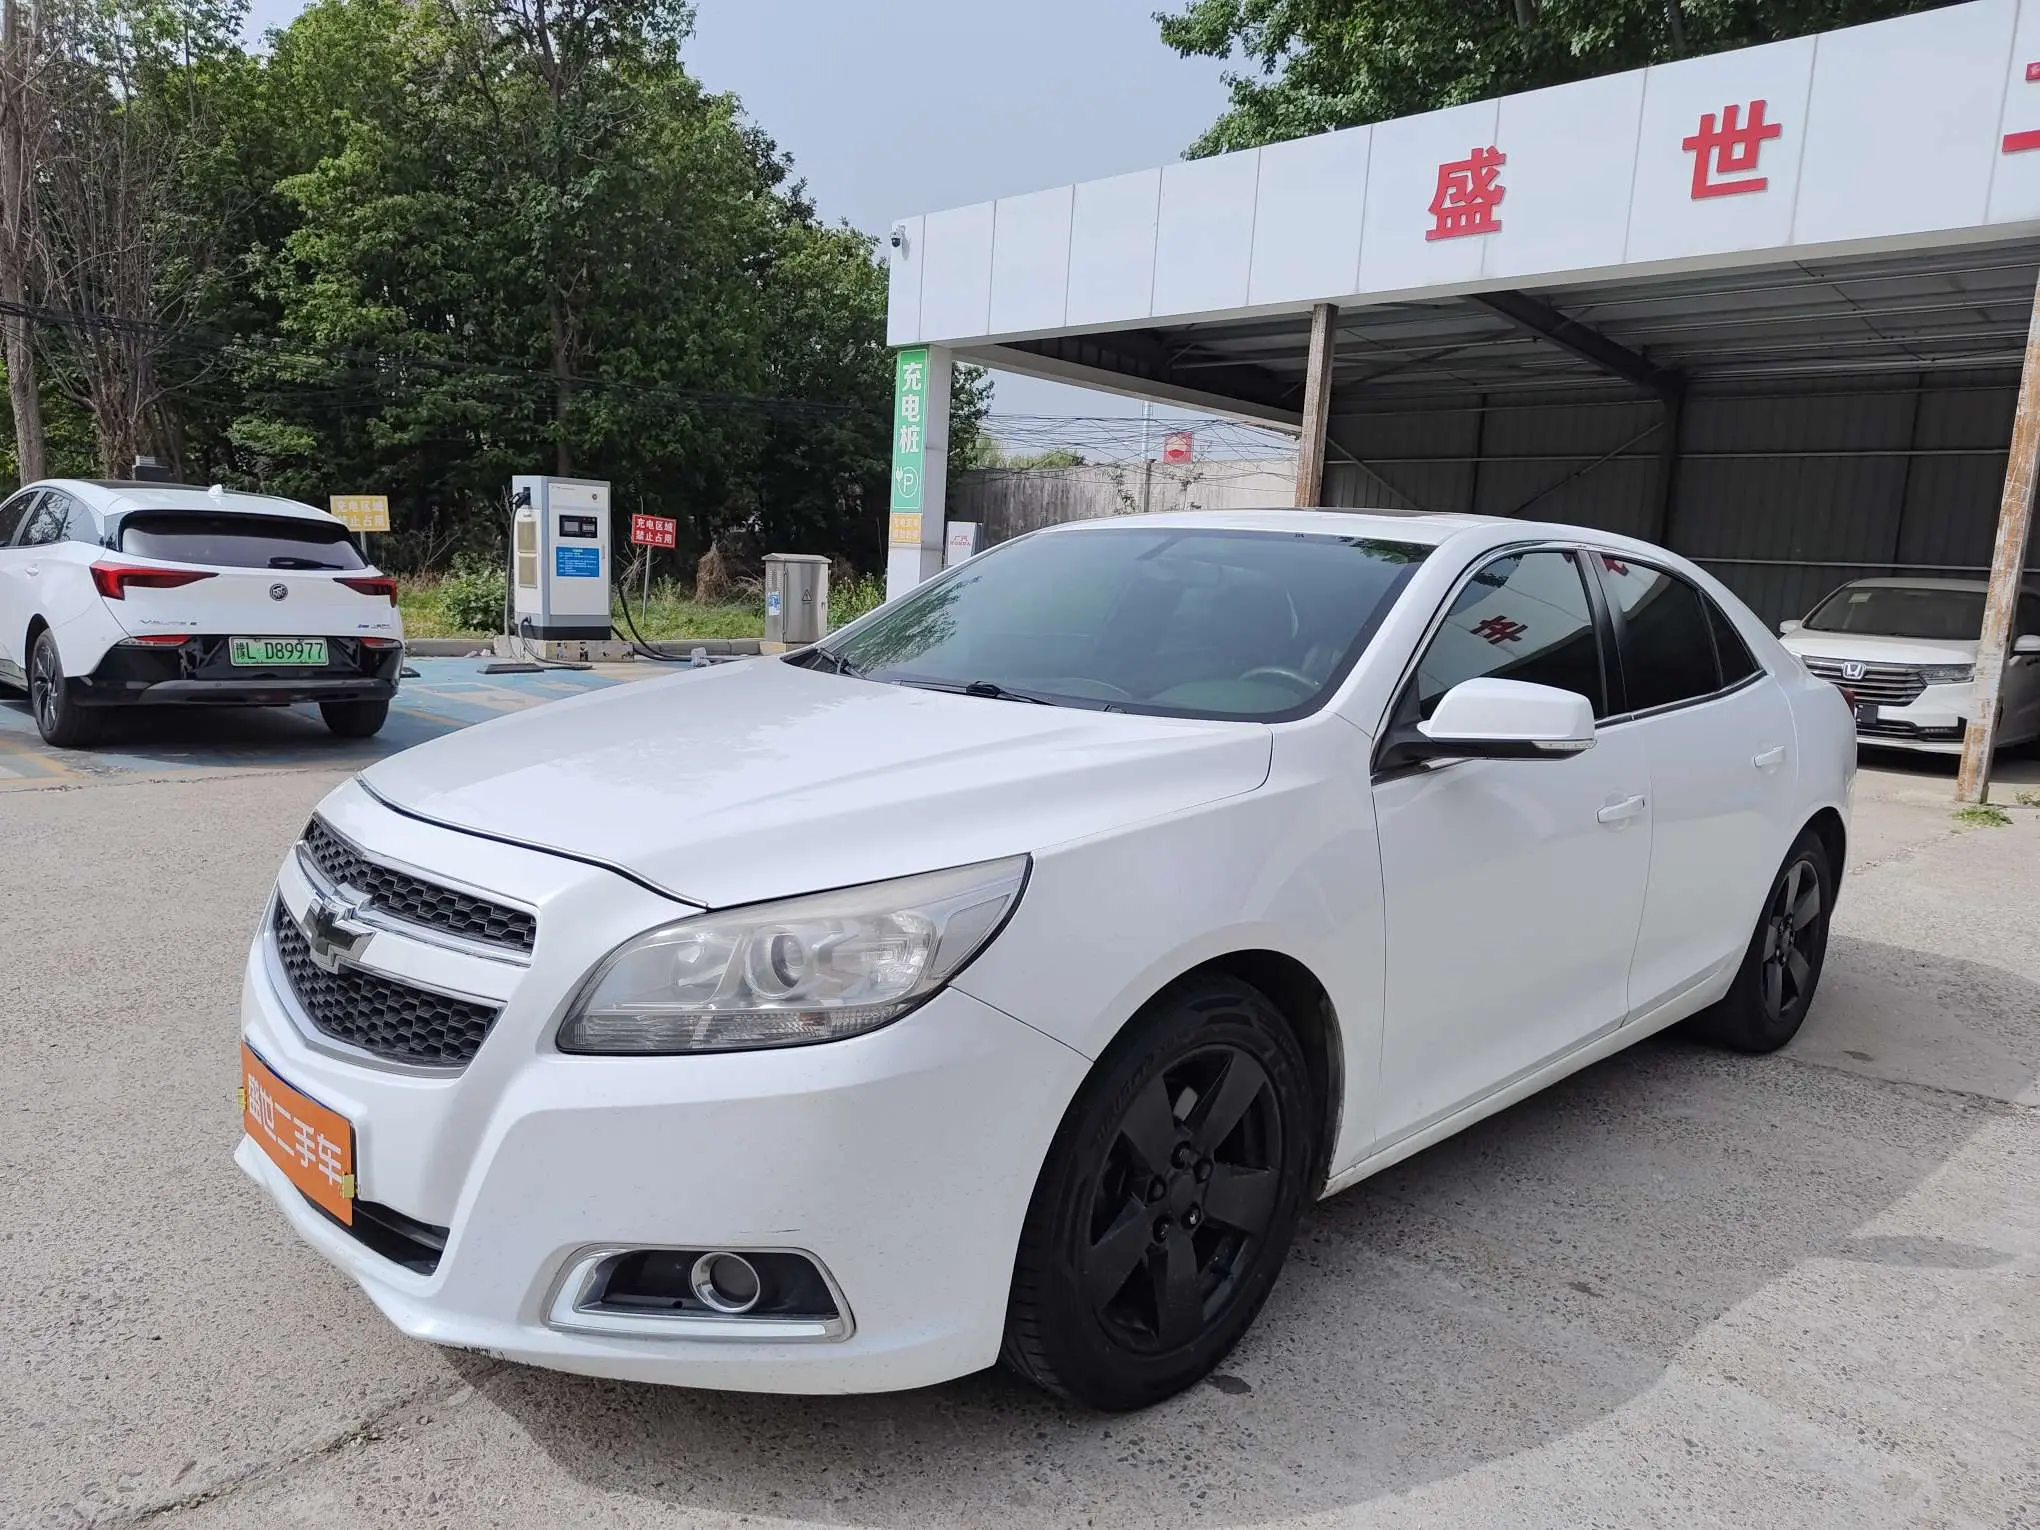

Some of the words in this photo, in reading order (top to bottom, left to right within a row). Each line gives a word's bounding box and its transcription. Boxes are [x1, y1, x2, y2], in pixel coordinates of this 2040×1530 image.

[900, 362, 922, 453] 充电桩
[636, 518, 673, 532] 充电区域
[635, 530, 672, 544] 禁止占用
[265, 642, 324, 661] D89977
